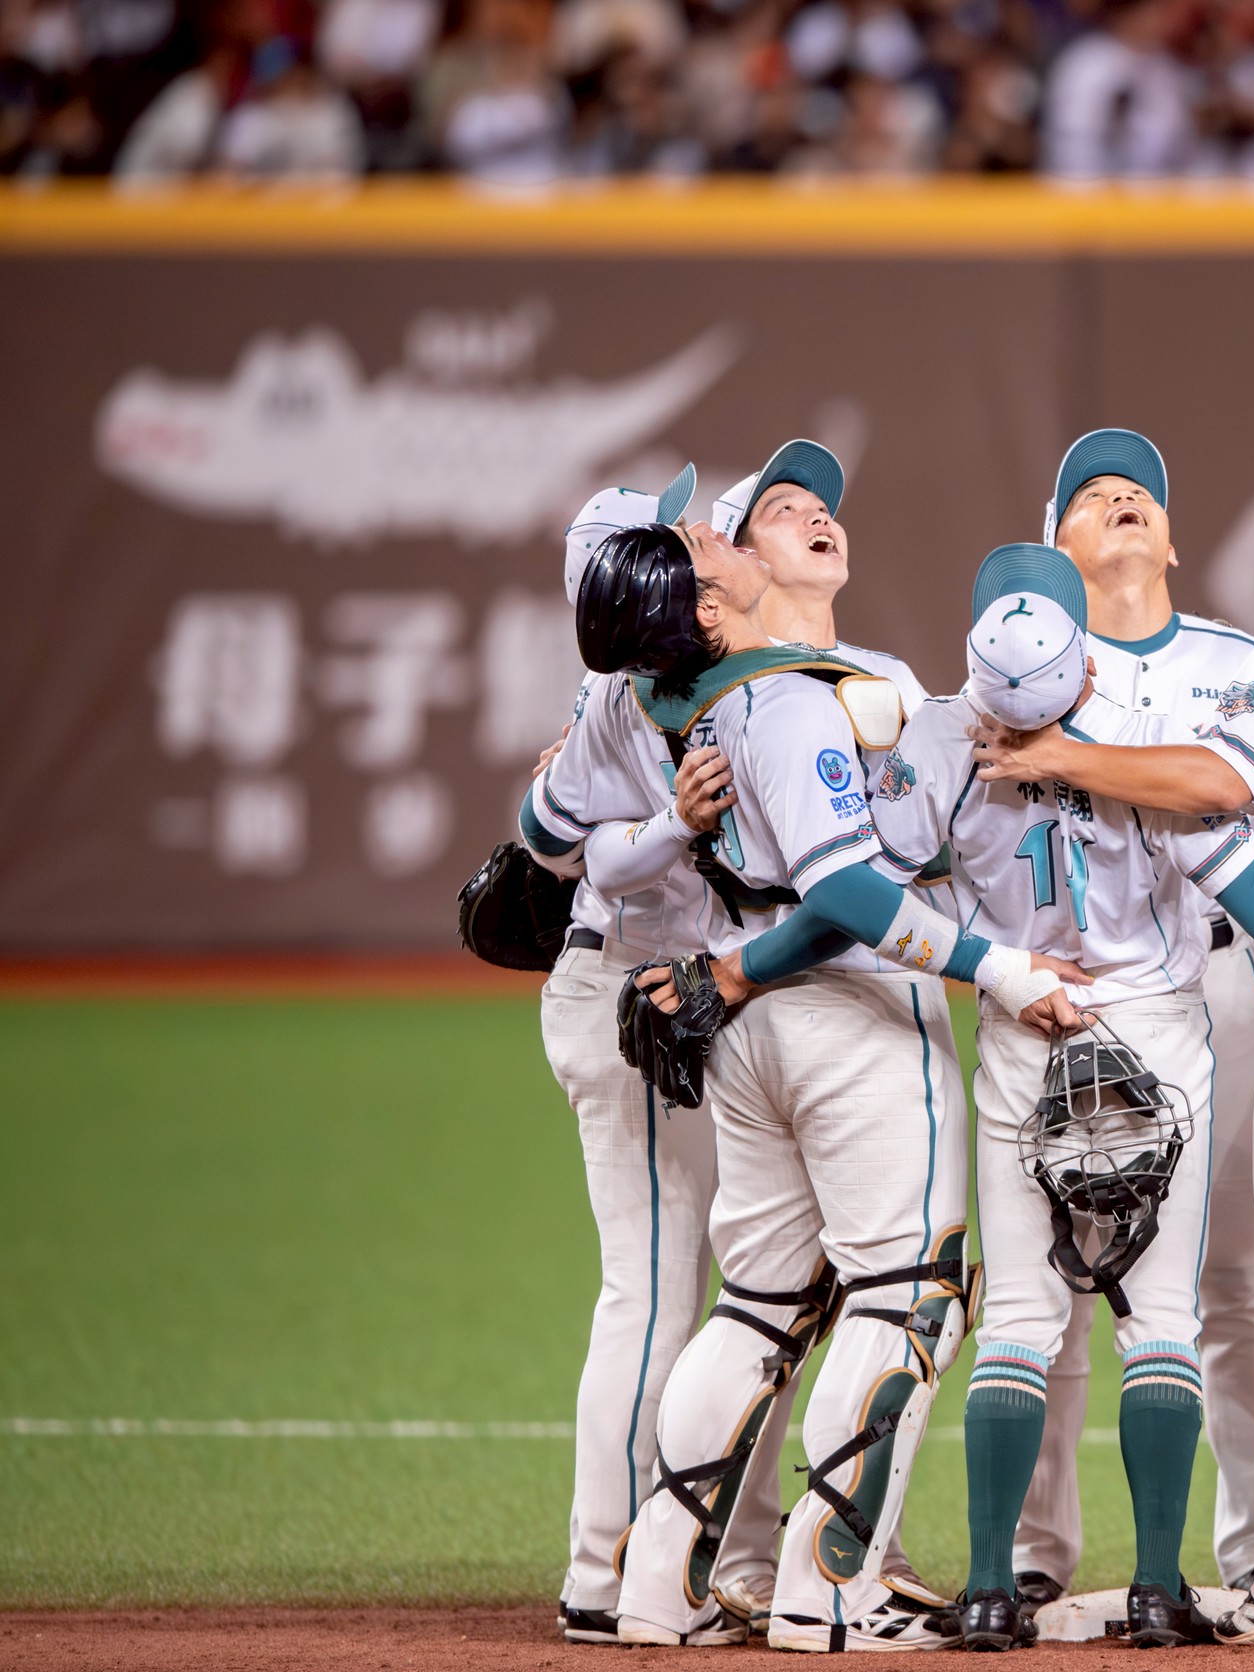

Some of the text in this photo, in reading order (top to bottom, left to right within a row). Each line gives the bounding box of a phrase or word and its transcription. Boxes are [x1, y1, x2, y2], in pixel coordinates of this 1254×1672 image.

[1191, 687, 1222, 699] D-Li
[830, 792, 865, 812] BRETT
[854, 802, 867, 815] BAS
